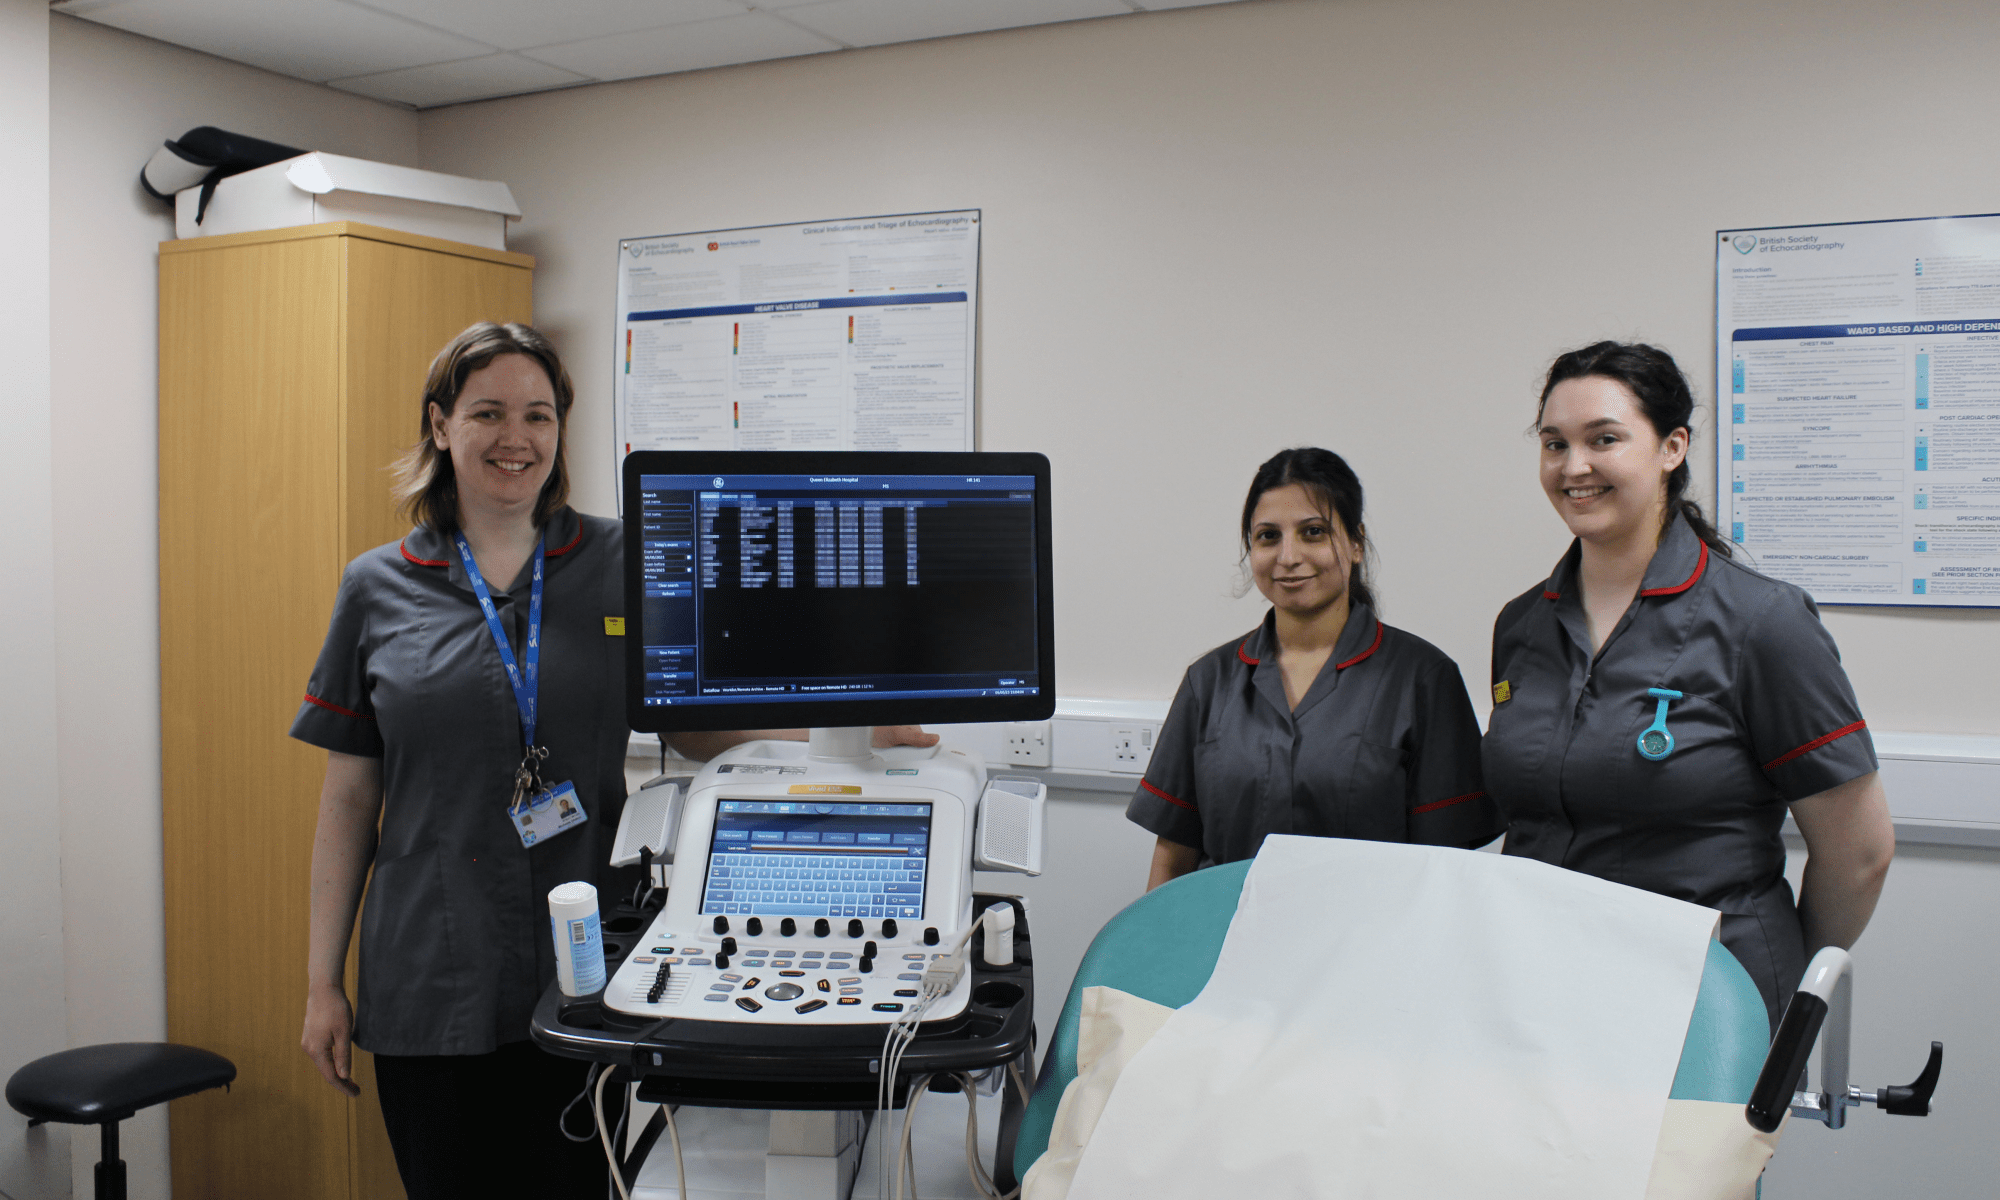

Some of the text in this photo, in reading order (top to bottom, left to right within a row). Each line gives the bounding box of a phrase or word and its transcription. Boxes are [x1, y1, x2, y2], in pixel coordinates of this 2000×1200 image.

[908, 216, 969, 227] Echocardiography
[1760, 235, 1818, 245] British Society
[651, 247, 694, 256] Echocardiography
[1760, 242, 1845, 253] of Echocardiography
[794, 301, 819, 310] DISEASE
[1847, 326, 1877, 335] WARD
[1878, 325, 1911, 334] BASED
[1913, 324, 1935, 333] AND
[1937, 324, 1962, 332] HIGH
